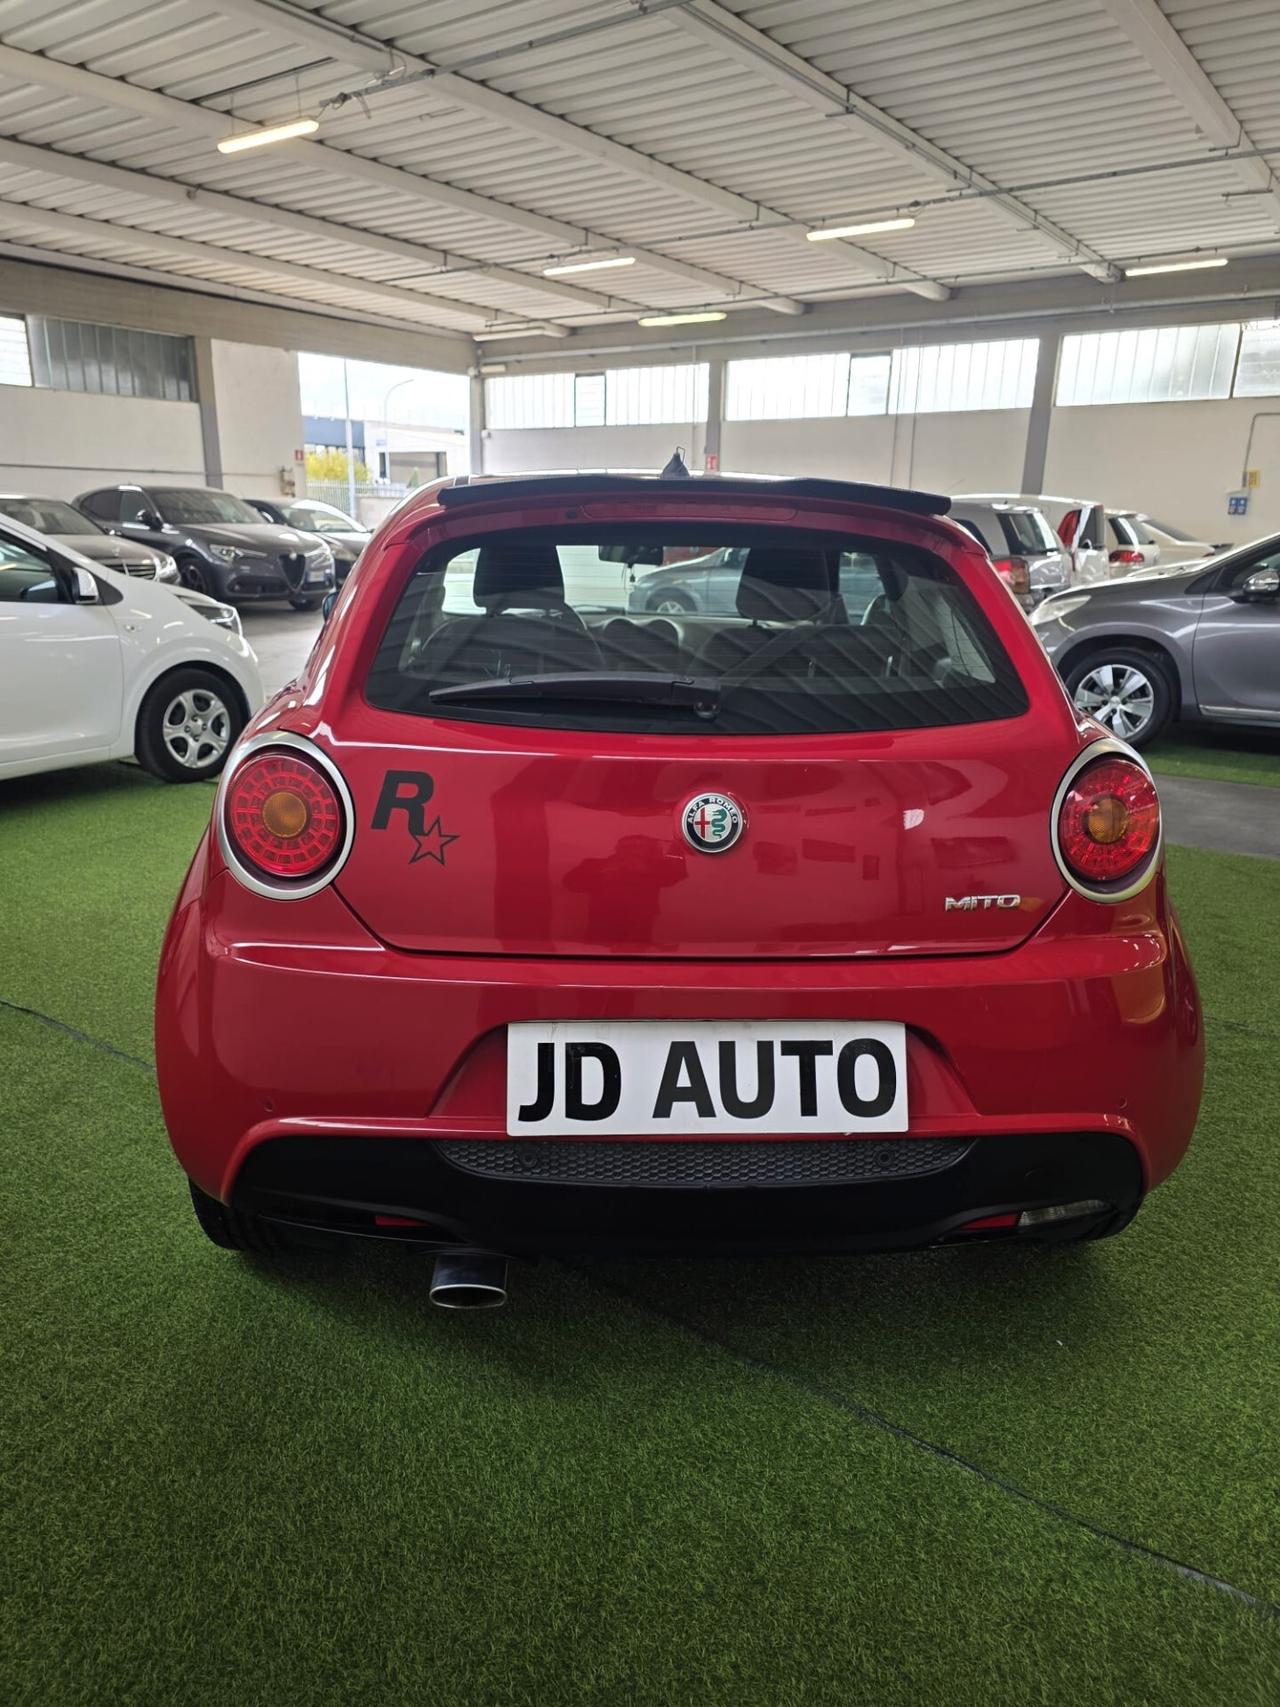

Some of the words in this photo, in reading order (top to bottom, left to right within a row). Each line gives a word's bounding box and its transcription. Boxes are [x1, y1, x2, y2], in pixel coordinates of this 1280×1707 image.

[371, 770, 434, 836] R
[687, 800, 706, 824] ALFA
[709, 797, 739, 824] ROMEO
[517, 1042, 622, 1122] JD
[652, 1038, 897, 1119] AUTO
